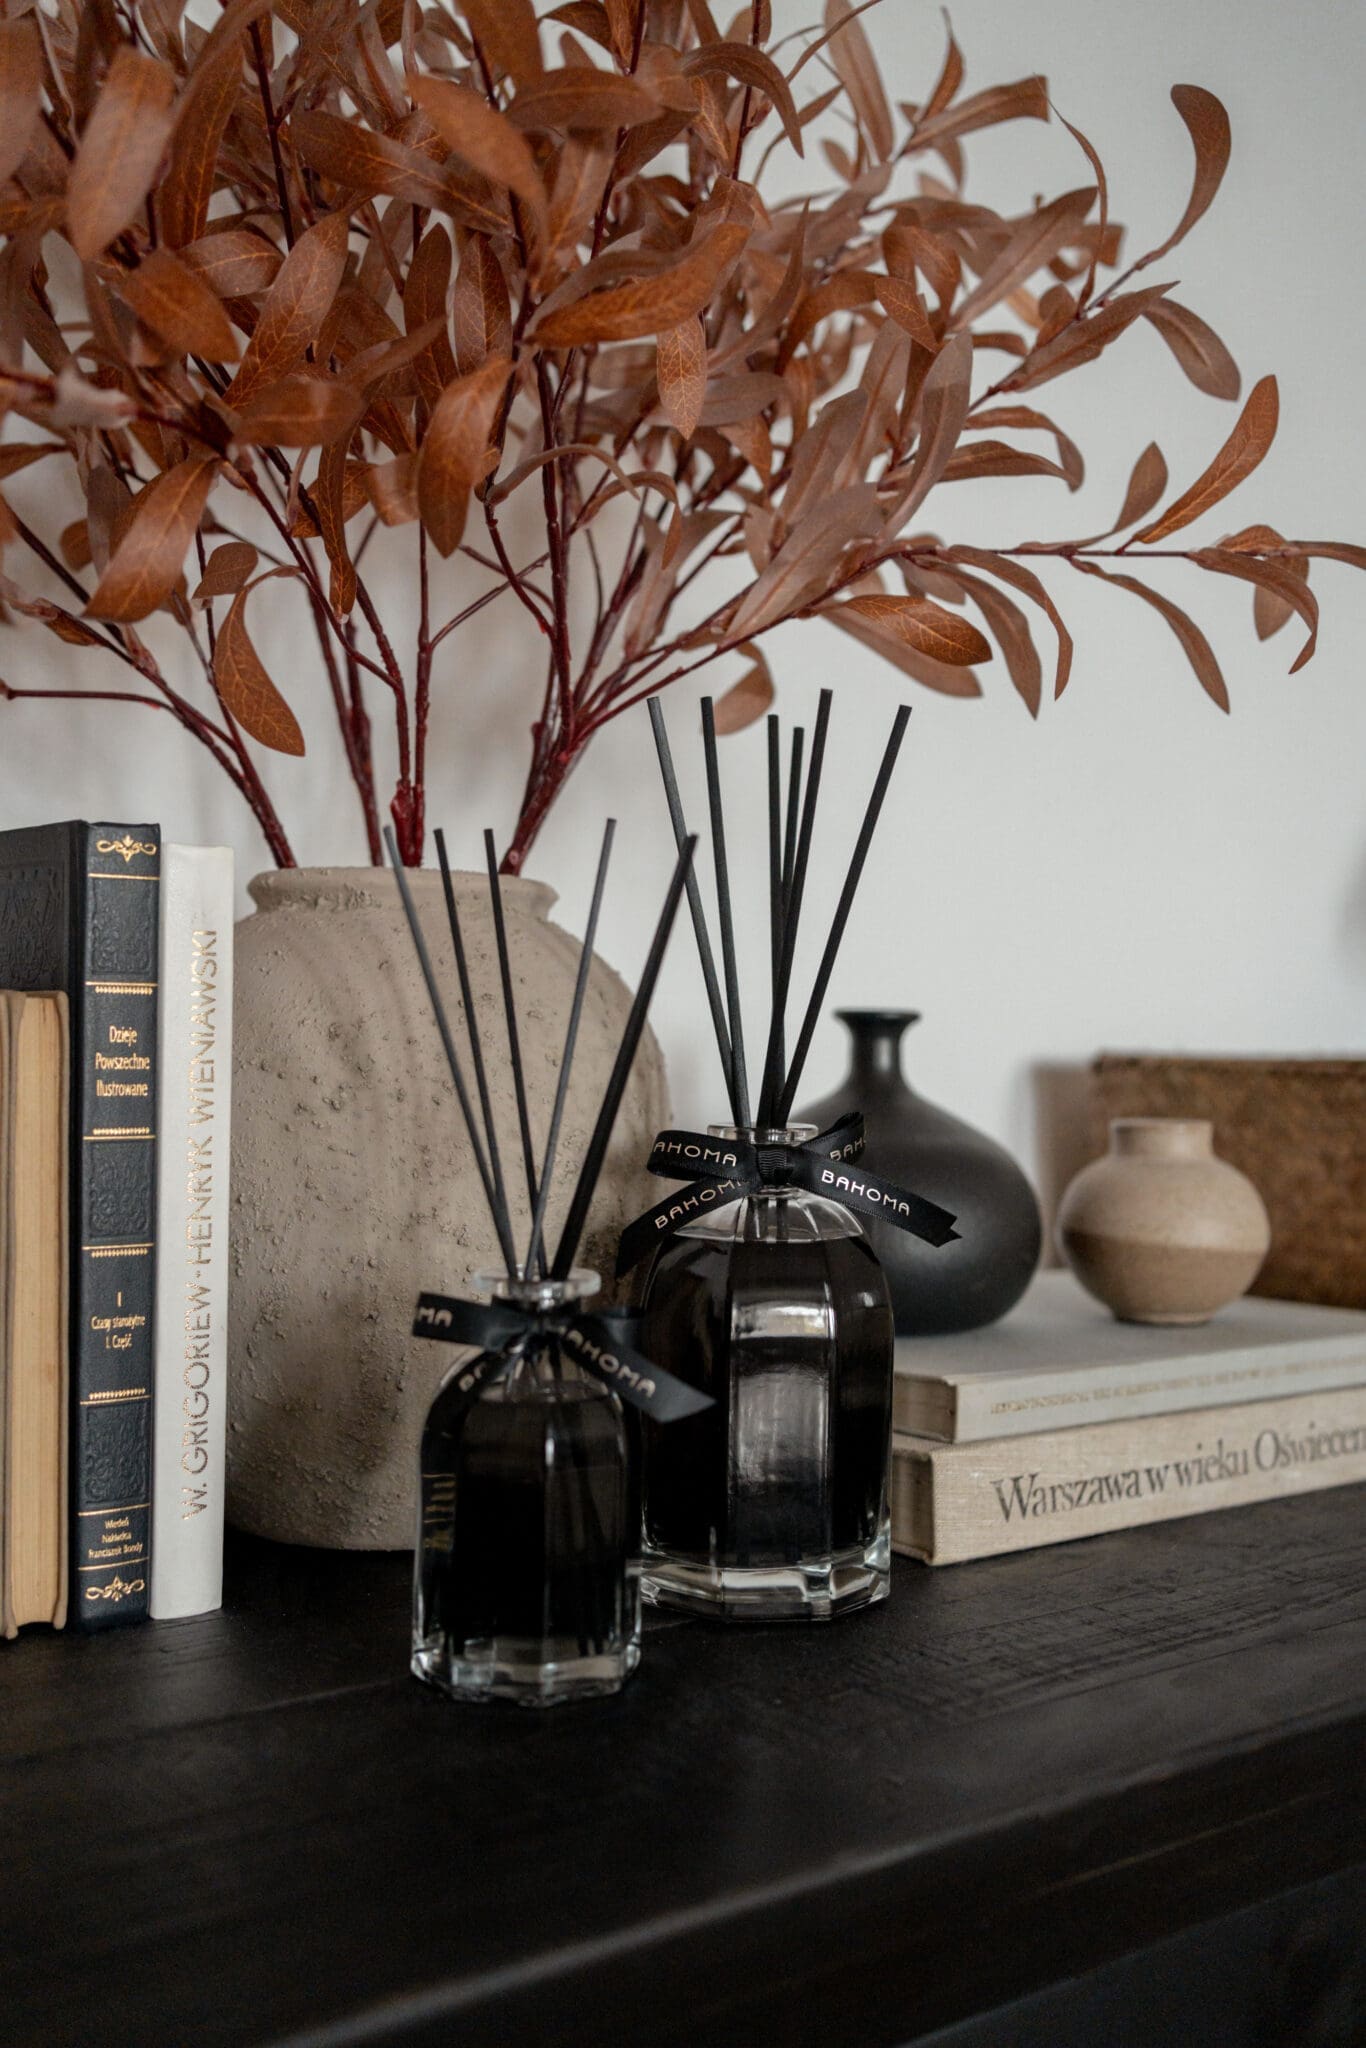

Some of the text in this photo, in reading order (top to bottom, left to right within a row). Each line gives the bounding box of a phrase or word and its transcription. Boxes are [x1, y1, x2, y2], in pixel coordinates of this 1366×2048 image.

[108, 1025, 138, 1047] Dzieje
[187, 929, 218, 1126] WIENIAWSKI
[95, 1052, 150, 1070] Powszechne
[96, 1079, 149, 1097] Ilustrowane
[829, 1137, 867, 1161] BAH
[186, 1136, 213, 1265] HENRYK
[821, 1169, 910, 1217] BAHOMA
[181, 1281, 211, 1475] GRIGORIEW
[559, 1325, 657, 1399] AHOMA
[990, 1470, 1142, 1524] Warszawa
[1144, 1463, 1171, 1495] w
[1172, 1439, 1249, 1488] wieku
